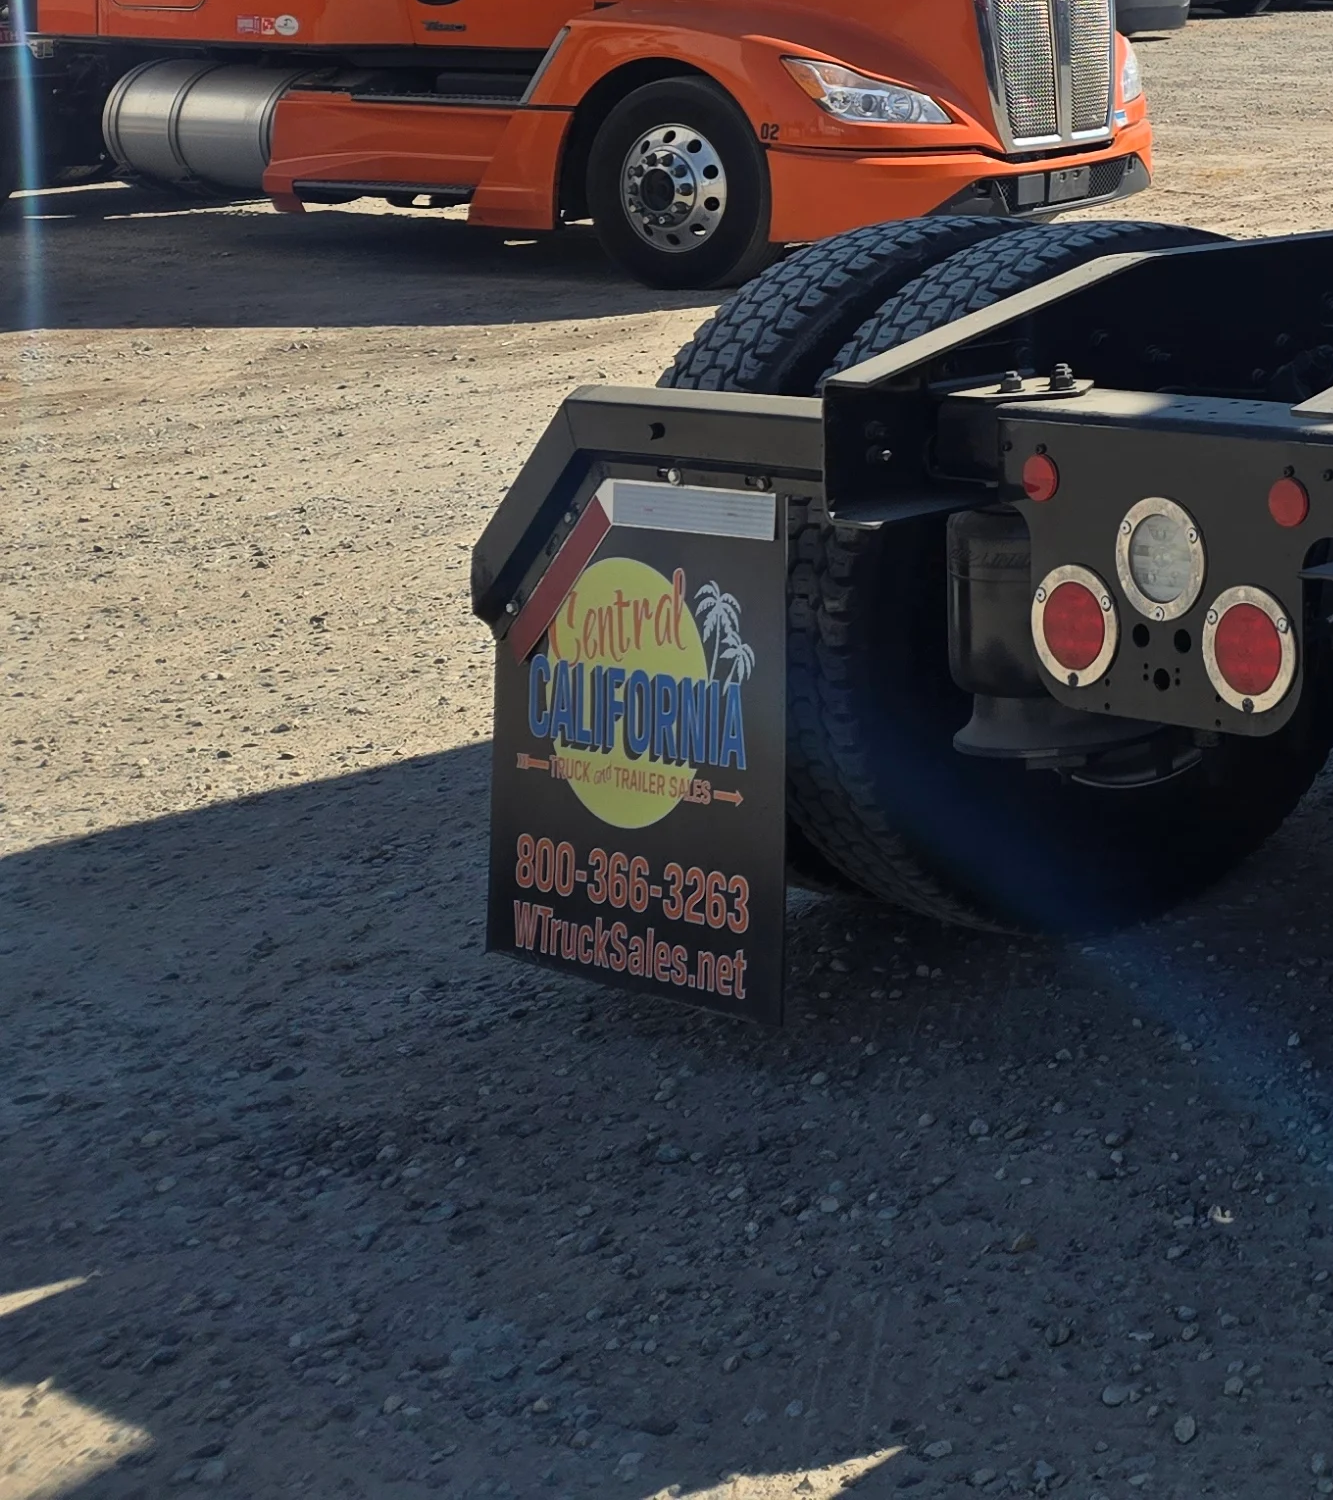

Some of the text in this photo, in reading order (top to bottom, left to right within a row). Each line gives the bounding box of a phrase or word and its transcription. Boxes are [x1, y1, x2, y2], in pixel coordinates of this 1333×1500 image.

[761, 122, 779, 140] 02
[548, 567, 687, 667] Central
[529, 652, 747, 770] CALIFORNIA
[549, 754, 712, 805] TRUCK and TRAILER SALES
[516, 832, 749, 934] 800-366-3263
[513, 900, 747, 1000] WTruckSales.net
